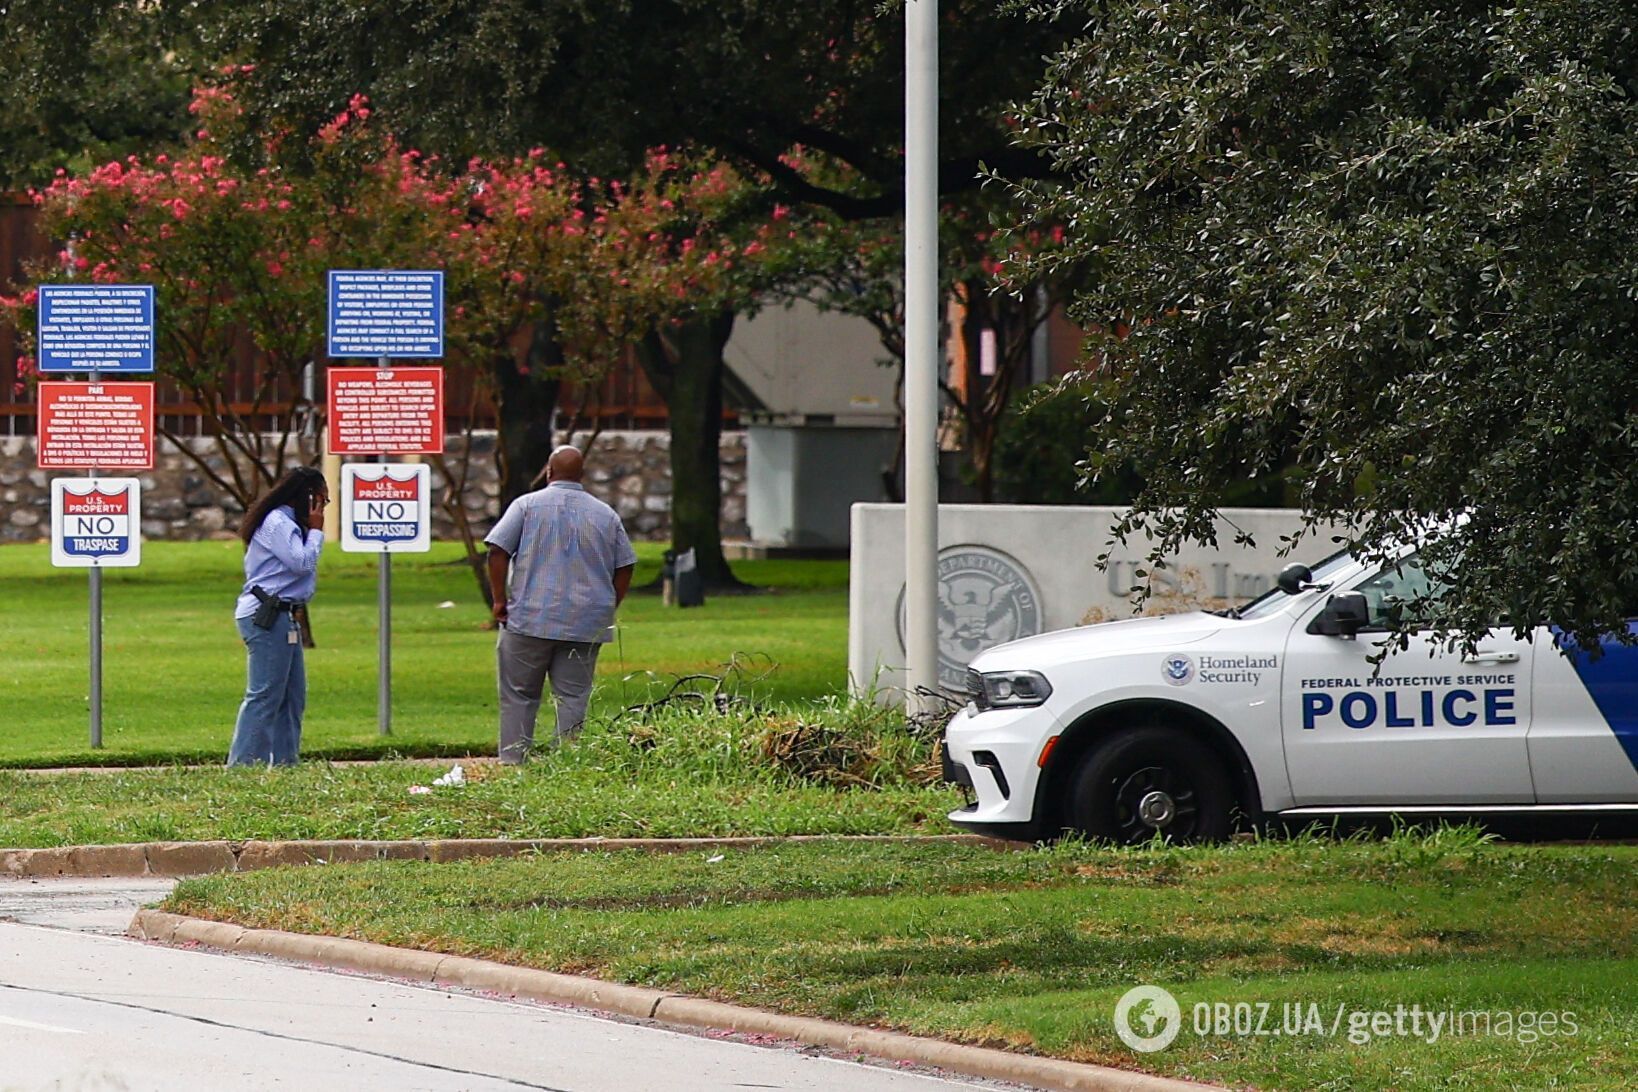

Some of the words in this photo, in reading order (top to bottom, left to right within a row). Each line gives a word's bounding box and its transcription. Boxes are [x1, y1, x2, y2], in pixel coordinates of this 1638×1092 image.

[376, 372, 394, 380] STOP
[88, 386, 104, 394] PARE
[359, 490, 413, 498] PROPERTY
[86, 497, 106, 505] U.S.
[69, 504, 123, 513] PROPERTY
[368, 502, 404, 520] NO
[78, 517, 114, 535] NO
[356, 524, 415, 537] TRESPASSING
[73, 538, 119, 551] TRASPASE
[937, 556, 1023, 591] EPARTMENT
[1018, 592, 1034, 612] OF
[1199, 655, 1277, 669] Homeland
[1199, 669, 1261, 686] Security
[1301, 678, 1361, 689] FEDERAL
[1366, 676, 1452, 688] PROTECTIVE
[1456, 675, 1515, 686] SERVICE
[1302, 689, 1516, 729] POLICE
